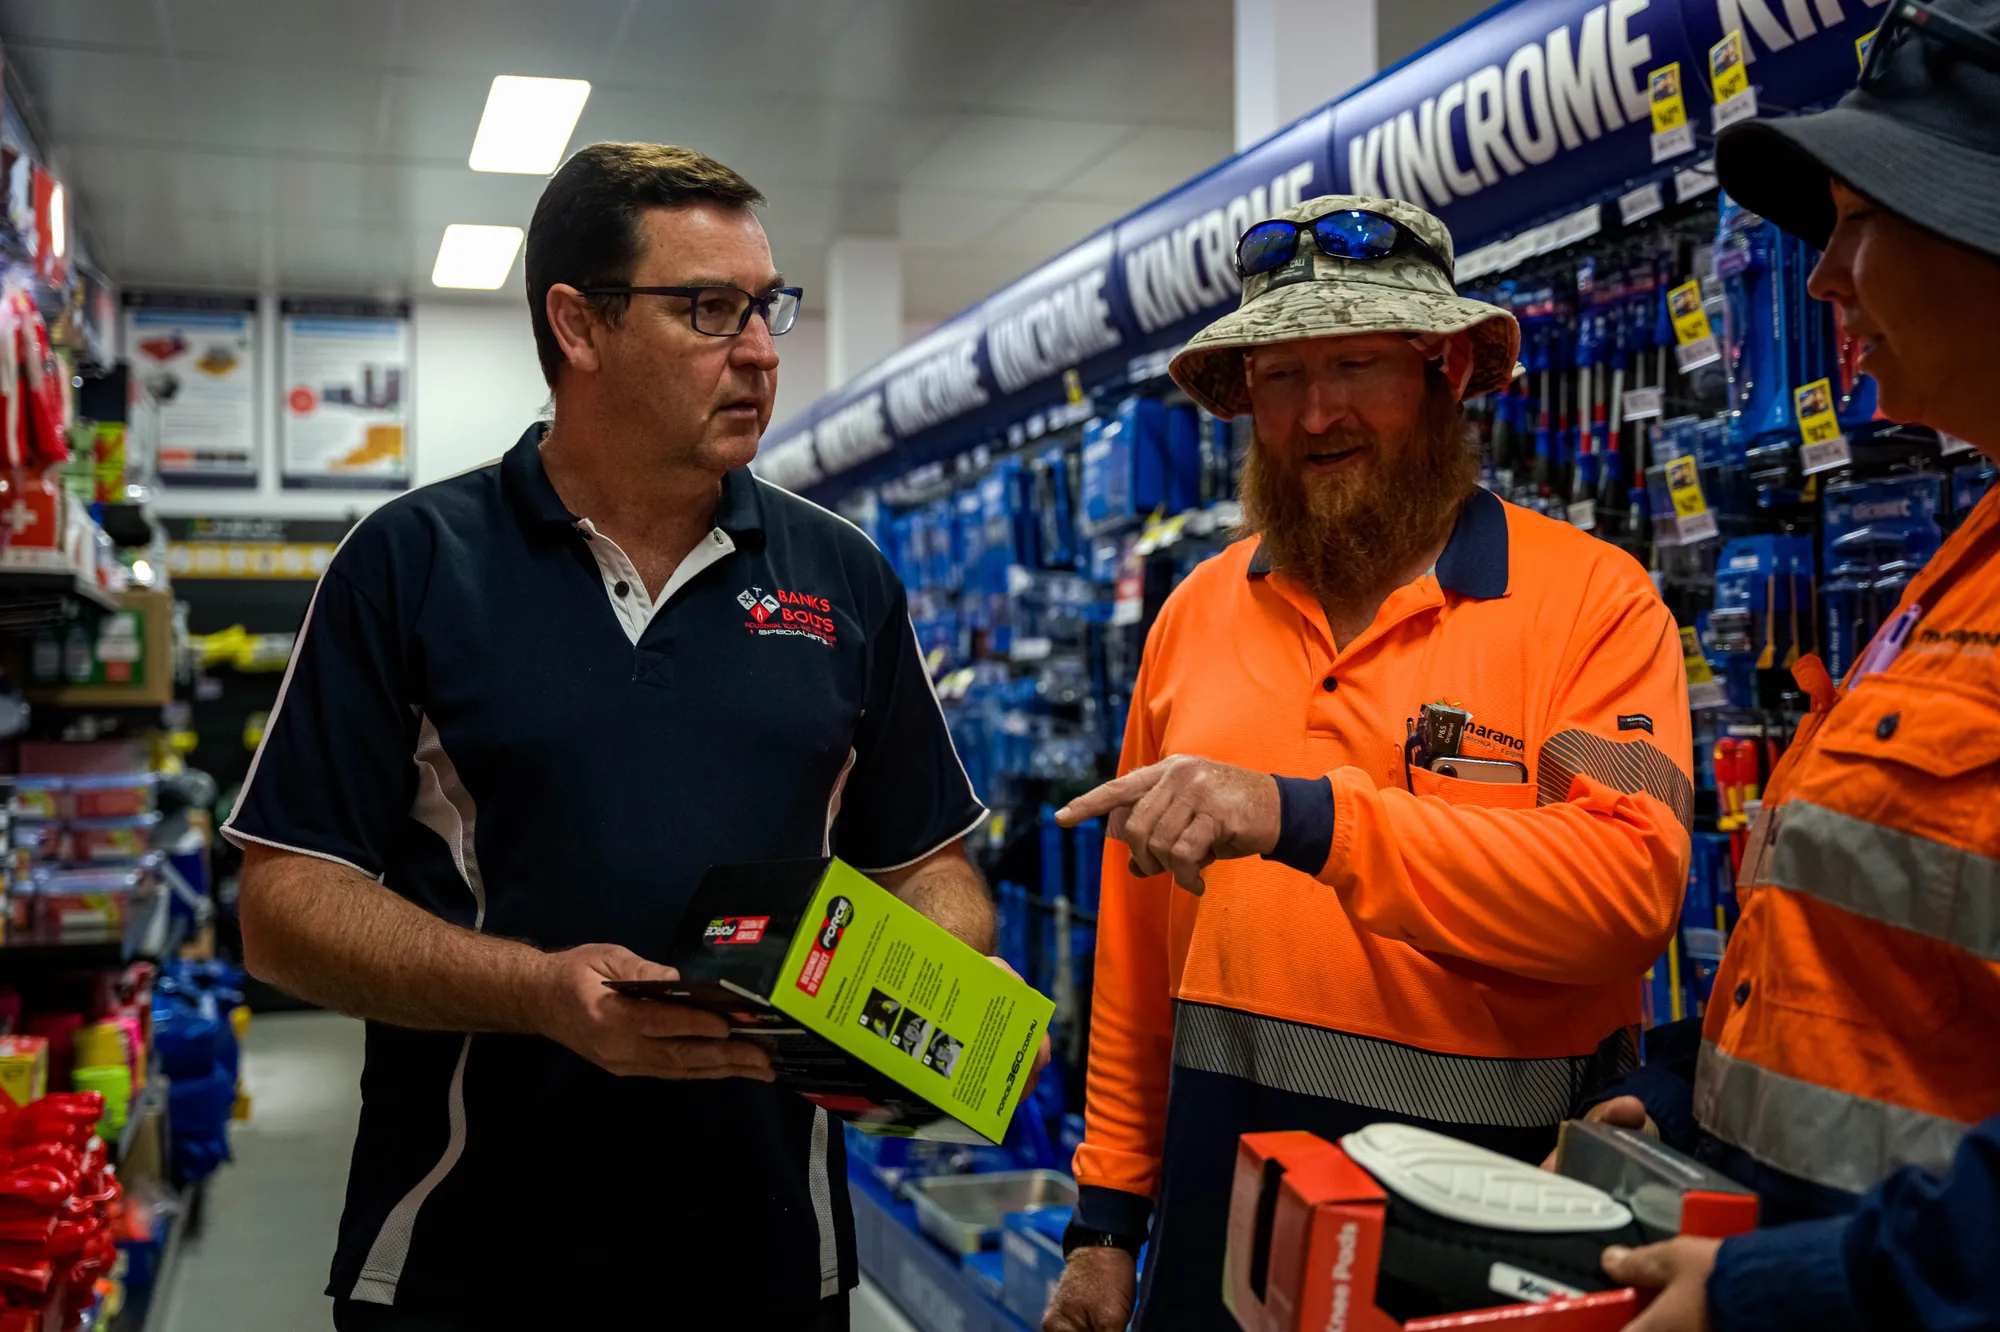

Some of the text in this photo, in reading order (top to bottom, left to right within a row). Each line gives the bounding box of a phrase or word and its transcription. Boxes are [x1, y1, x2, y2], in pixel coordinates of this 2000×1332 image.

[1348, 0, 1652, 206] KINCROME
[777, 589, 831, 613] BANKS
[781, 607, 835, 633] BOLTS
[1437, 725, 1447, 739] P&S
[1444, 722, 1454, 744] Original
[822, 898, 849, 948] FORCE
